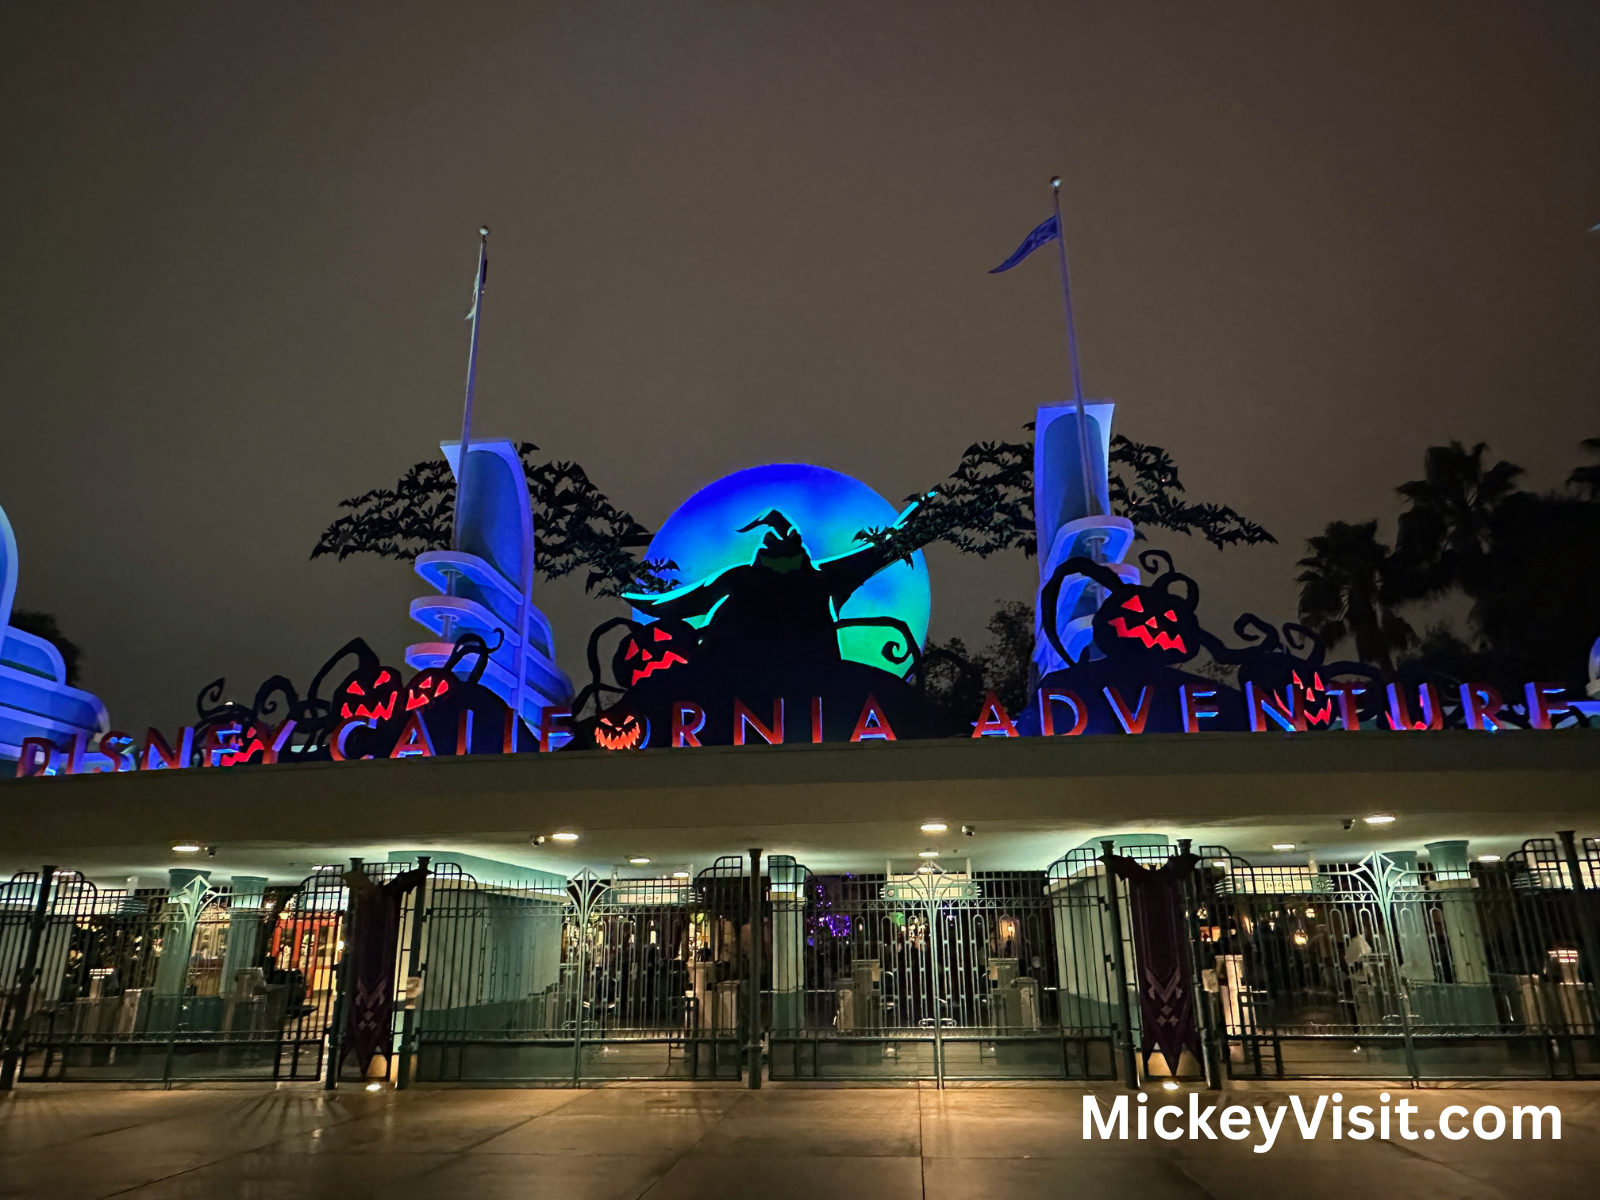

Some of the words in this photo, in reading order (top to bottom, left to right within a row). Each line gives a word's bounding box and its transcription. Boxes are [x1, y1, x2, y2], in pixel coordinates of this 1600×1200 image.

[16, 719, 298, 777] DISNEY
[329, 693, 898, 761] CALIFRNIA
[971, 680, 1569, 738] ADVENTURE
